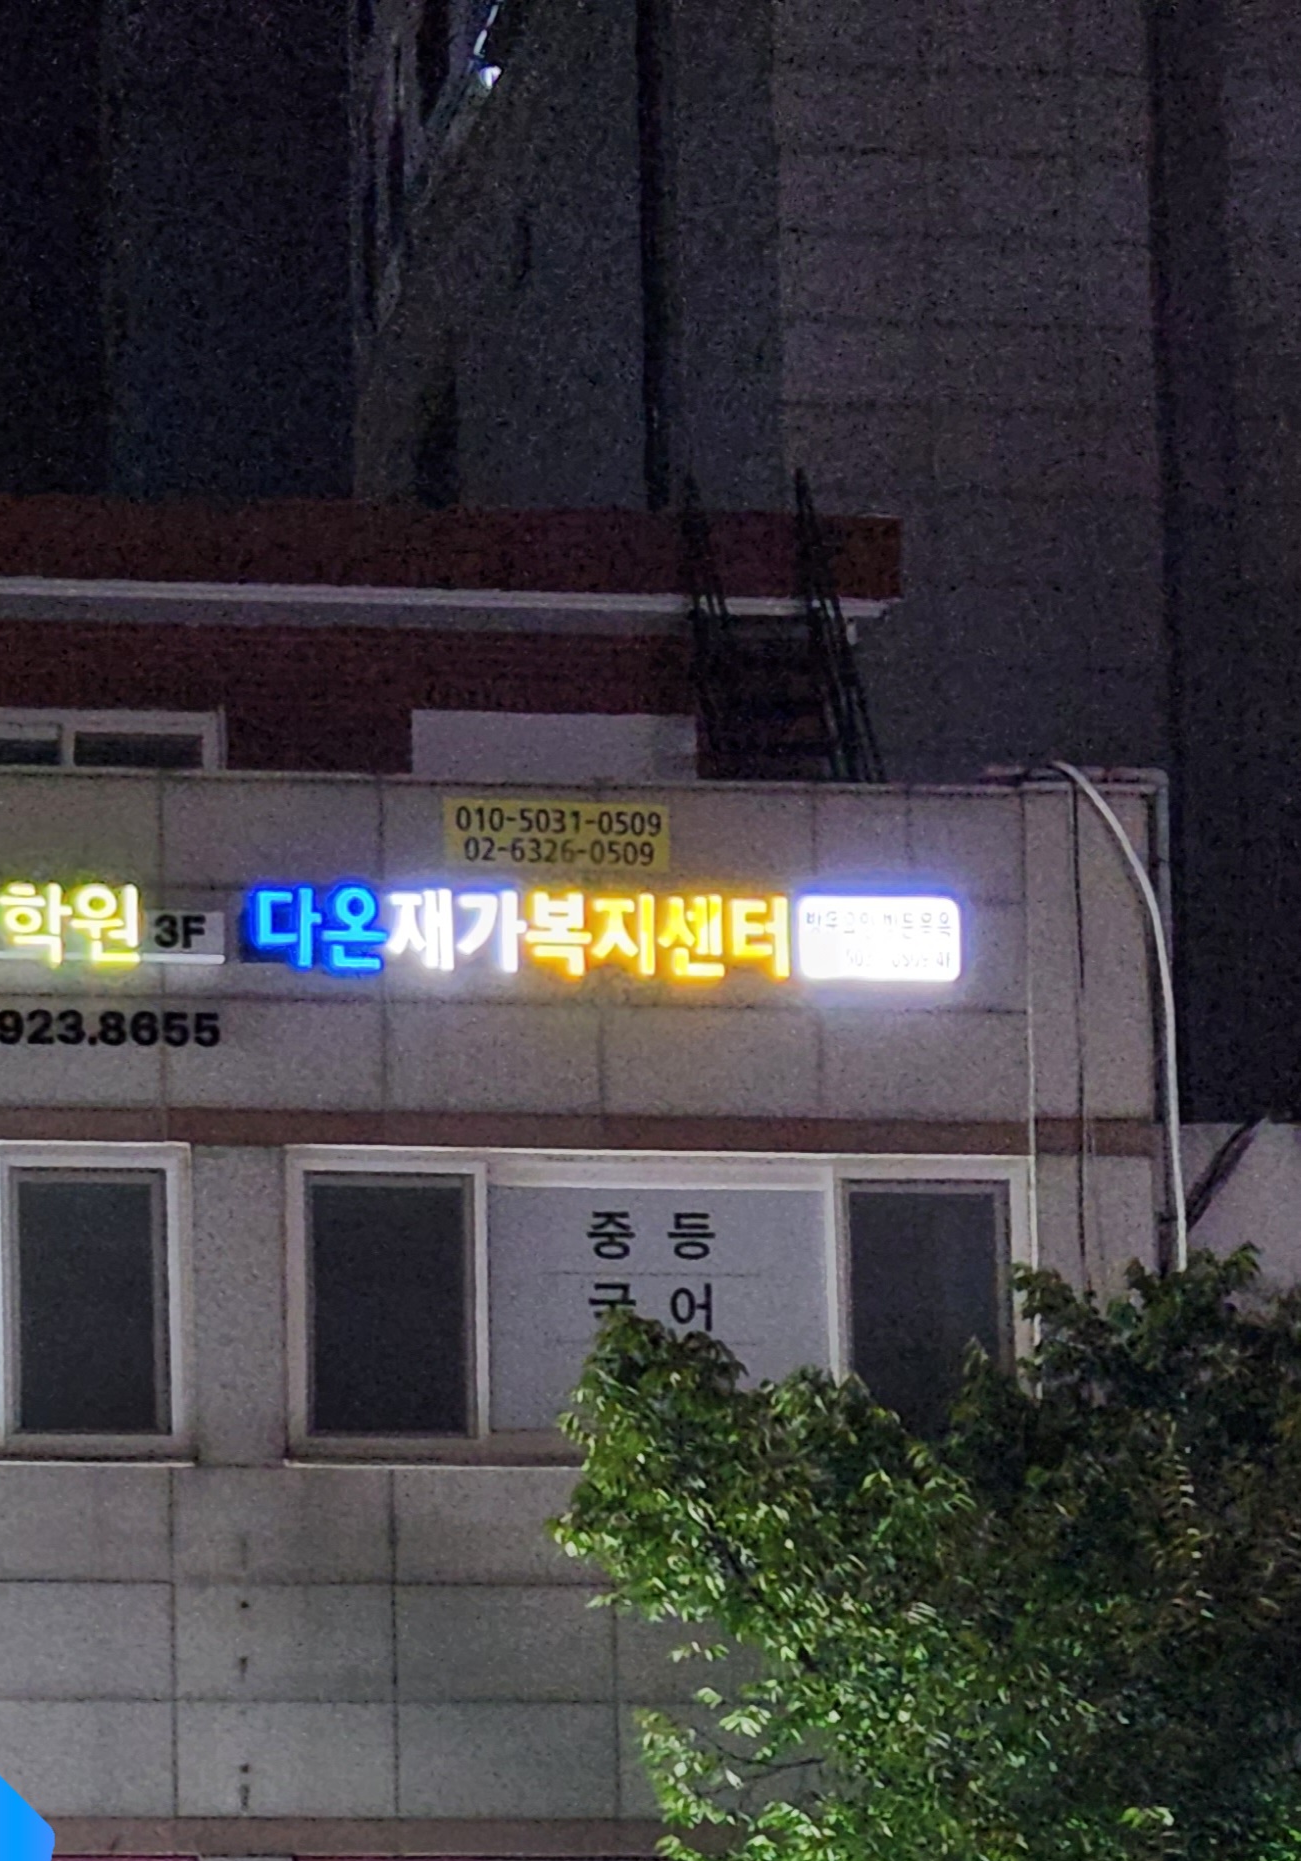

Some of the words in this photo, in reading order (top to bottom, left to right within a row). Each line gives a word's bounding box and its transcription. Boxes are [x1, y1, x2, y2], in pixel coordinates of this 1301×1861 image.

[454, 804, 663, 838] 010-5031-0509
[462, 836, 656, 867] 02-6326-0509
[153, 913, 207, 949] 3F
